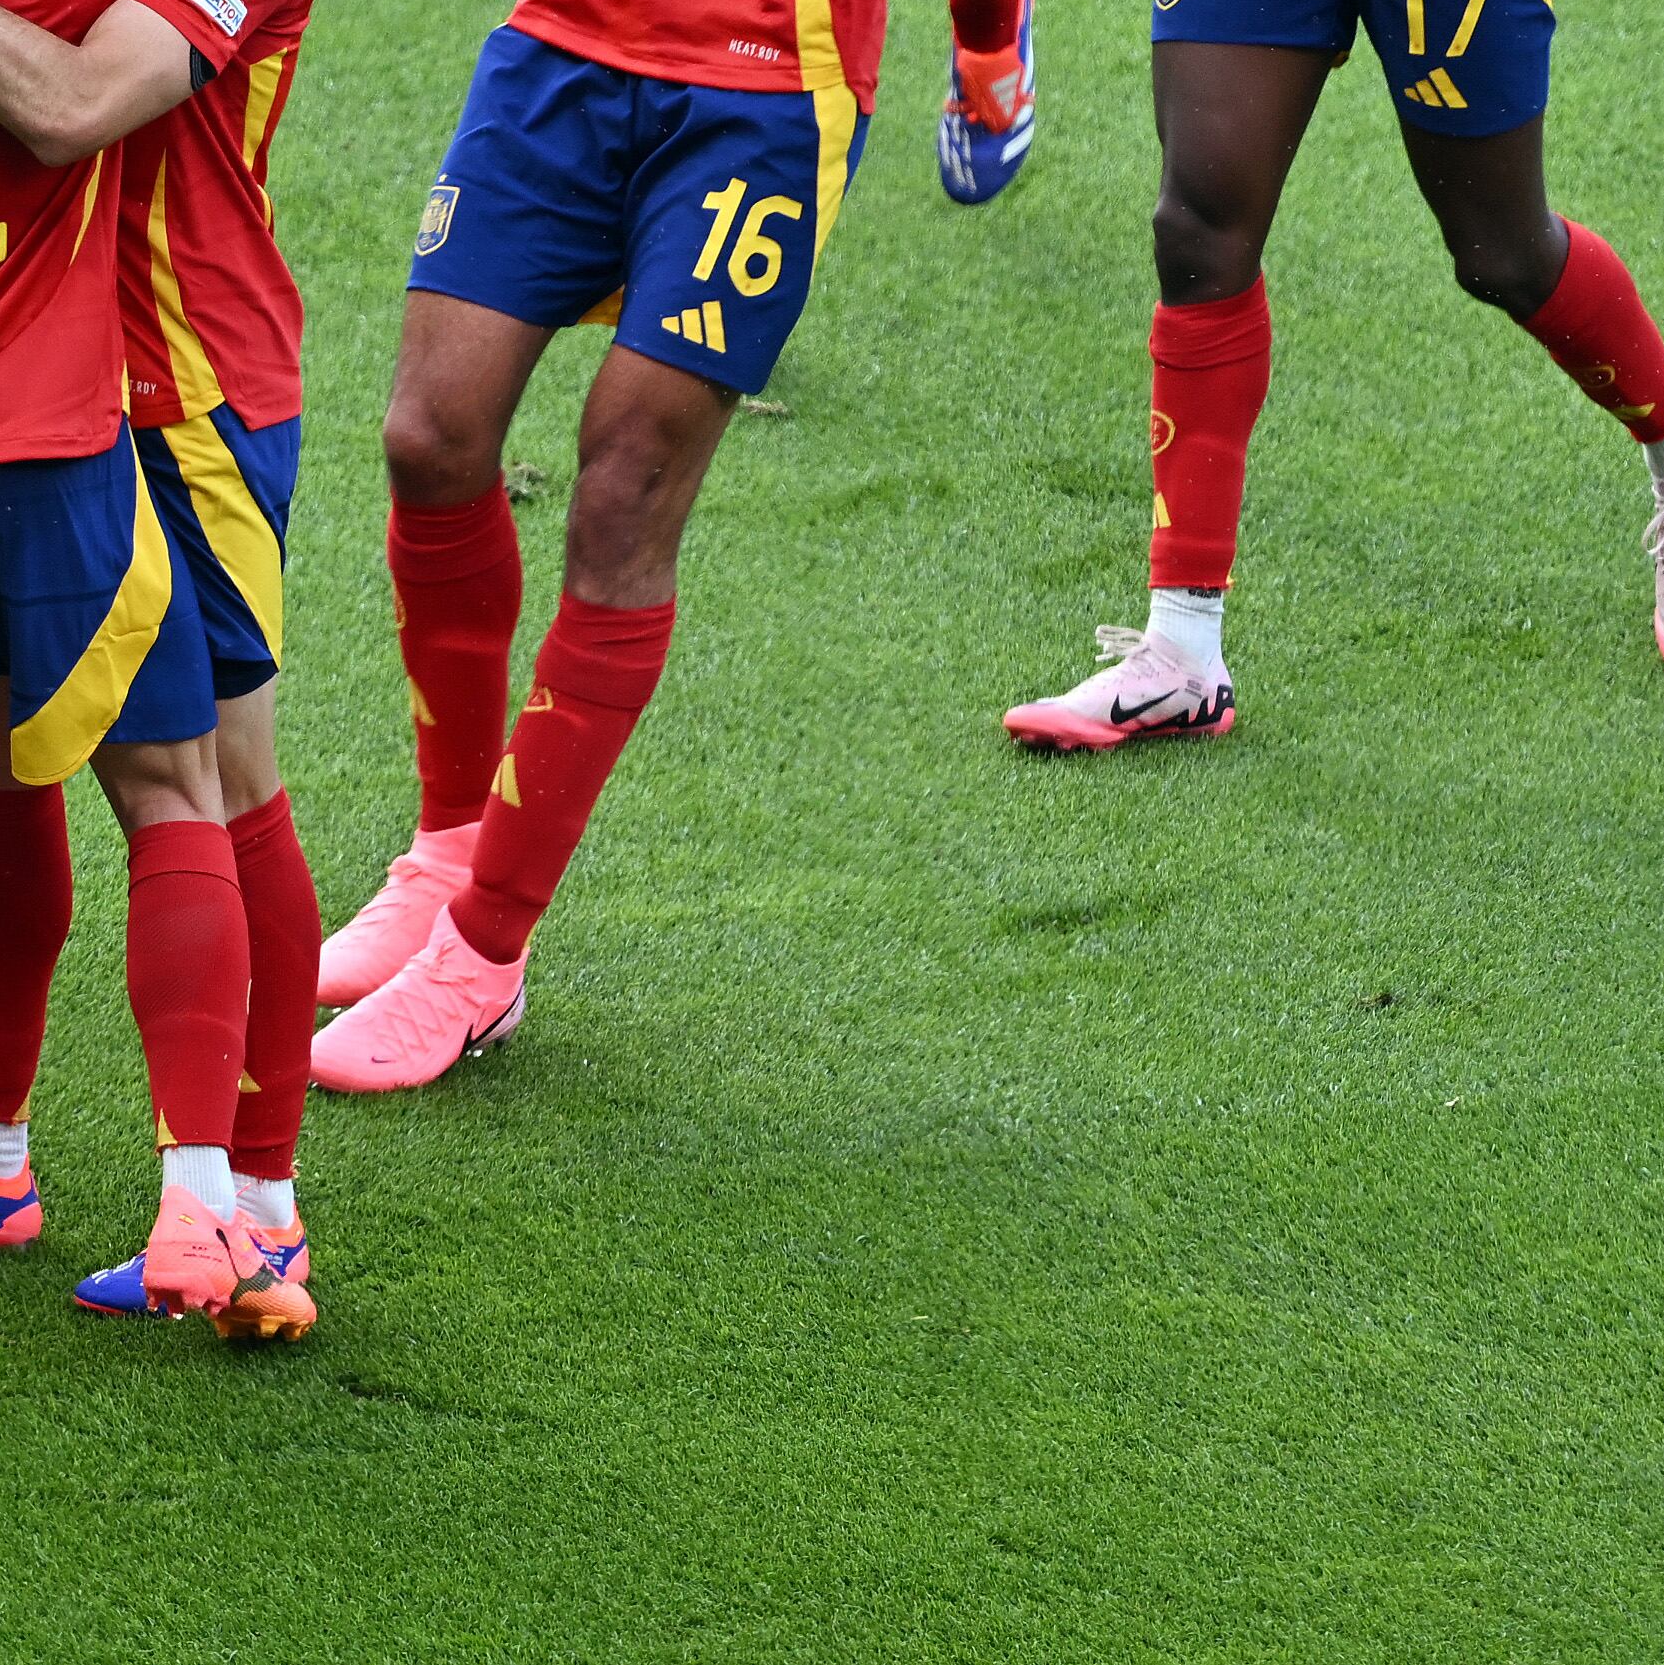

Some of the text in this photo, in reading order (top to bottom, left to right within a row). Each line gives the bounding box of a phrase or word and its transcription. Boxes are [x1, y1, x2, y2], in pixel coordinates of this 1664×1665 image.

[728, 38, 781, 62] HEAT.RDY
[692, 177, 803, 297] 16
[129, 379, 157, 396] T.RDY
